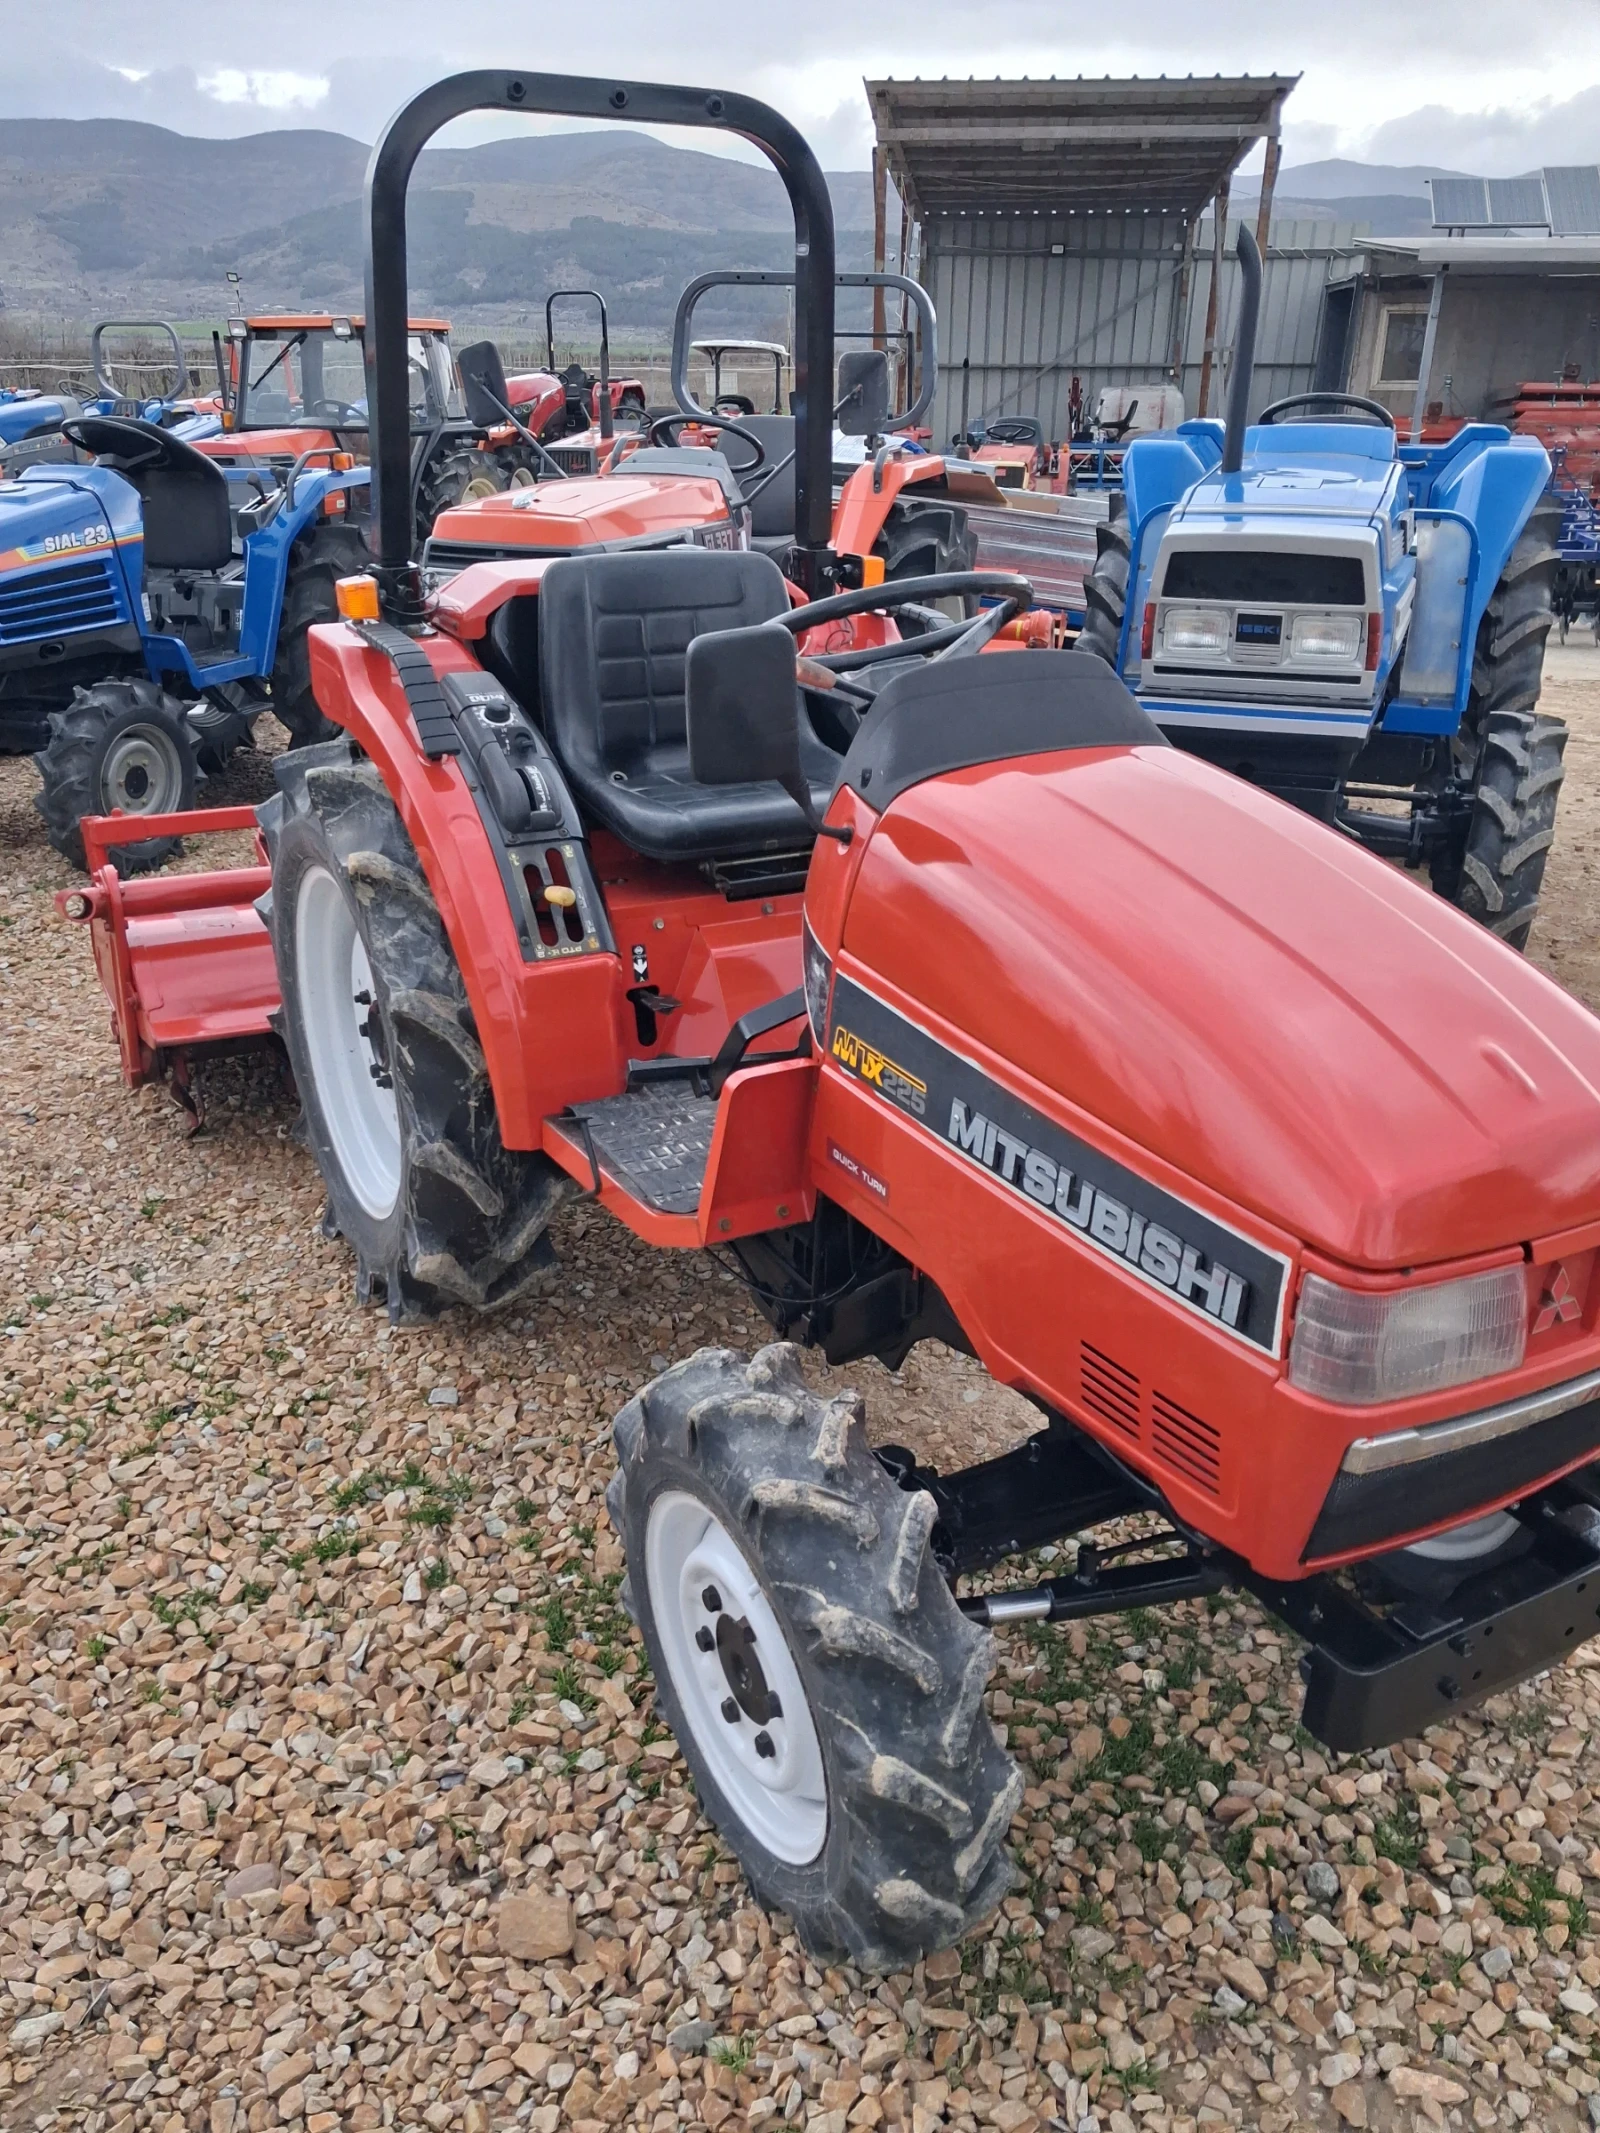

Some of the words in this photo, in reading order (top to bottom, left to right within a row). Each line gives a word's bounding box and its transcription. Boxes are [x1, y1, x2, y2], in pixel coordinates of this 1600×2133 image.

[44, 532, 81, 553] SIAL
[83, 524, 109, 546] 23
[1238, 624, 1280, 634] ISEKI
[833, 1148, 859, 1175] QUICK
[861, 1170, 886, 1197] TURN
[948, 1096, 1247, 1328] MITSUBISHI
